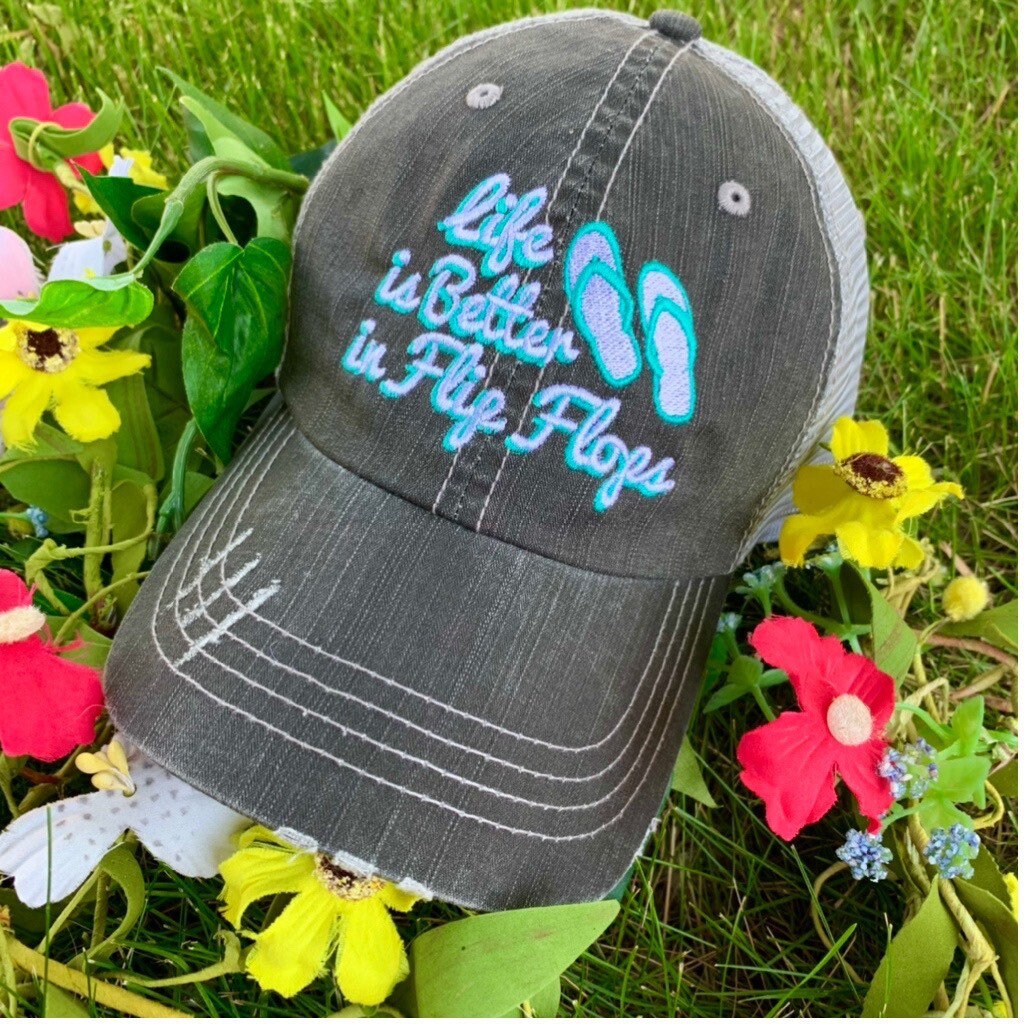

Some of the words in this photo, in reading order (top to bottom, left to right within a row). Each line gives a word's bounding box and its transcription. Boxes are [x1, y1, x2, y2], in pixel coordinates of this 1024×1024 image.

[437, 173, 553, 278] Life
[374, 249, 422, 314] is
[417, 253, 579, 366] Better
[341, 318, 387, 382] in
[379, 332, 507, 451] Flip
[504, 384, 676, 512] Flops
